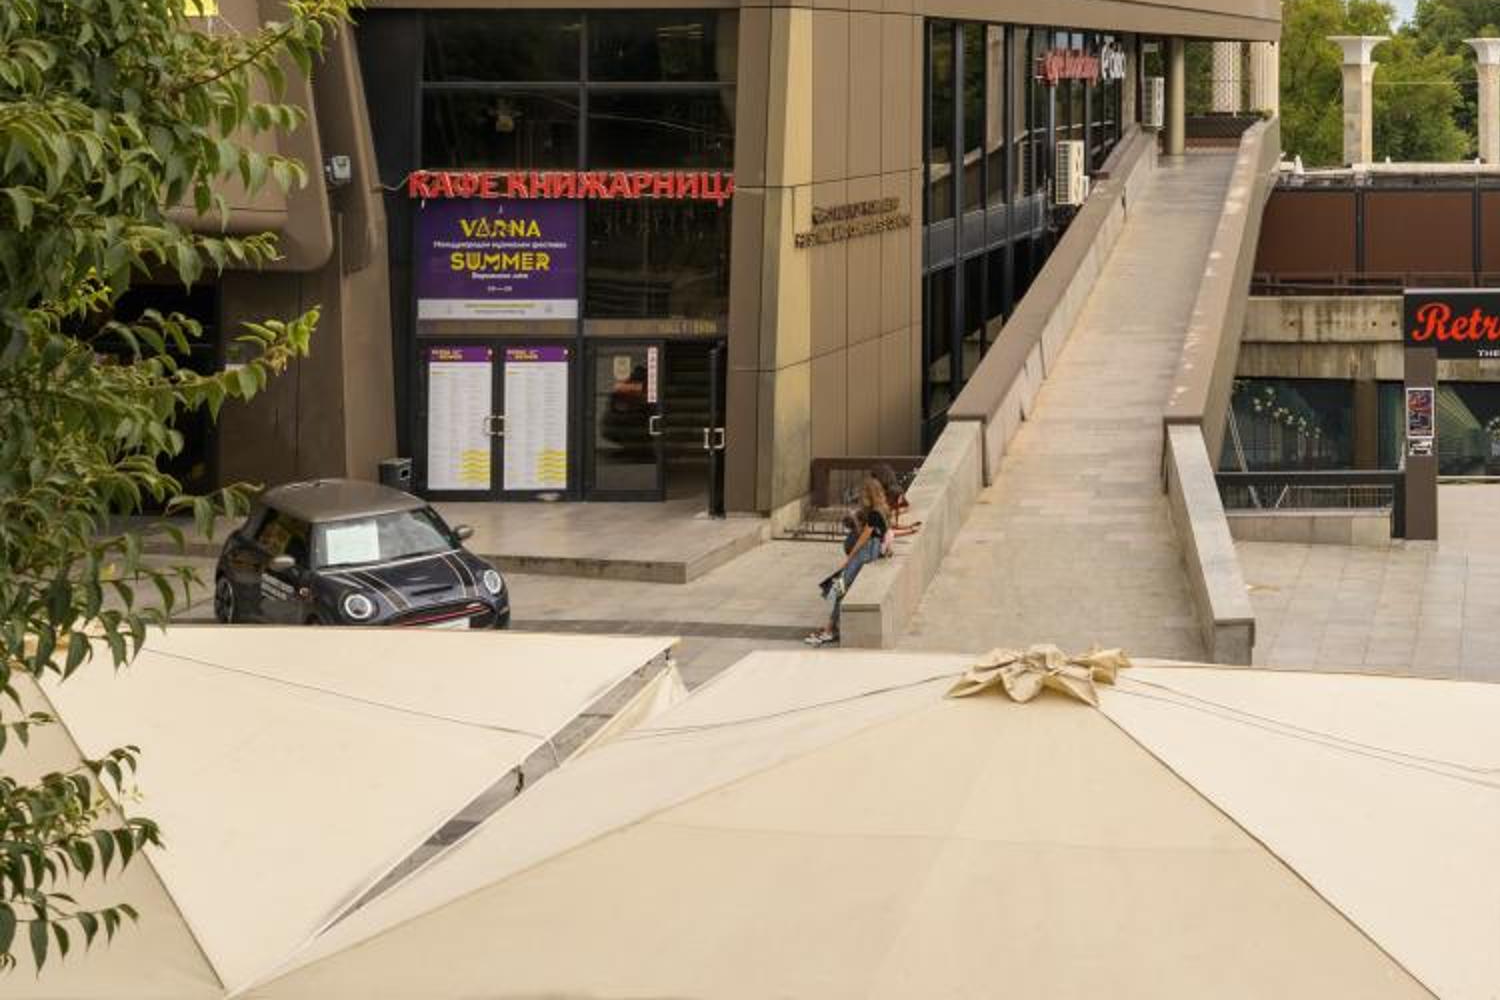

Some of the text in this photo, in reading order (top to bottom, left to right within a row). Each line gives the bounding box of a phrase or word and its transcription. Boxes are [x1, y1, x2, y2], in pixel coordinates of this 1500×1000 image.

[408, 170, 499, 198] КАФЕ
[459, 216, 542, 238] VARNA
[450, 252, 551, 272] SUMMER
[1477, 349, 1500, 358] THE
